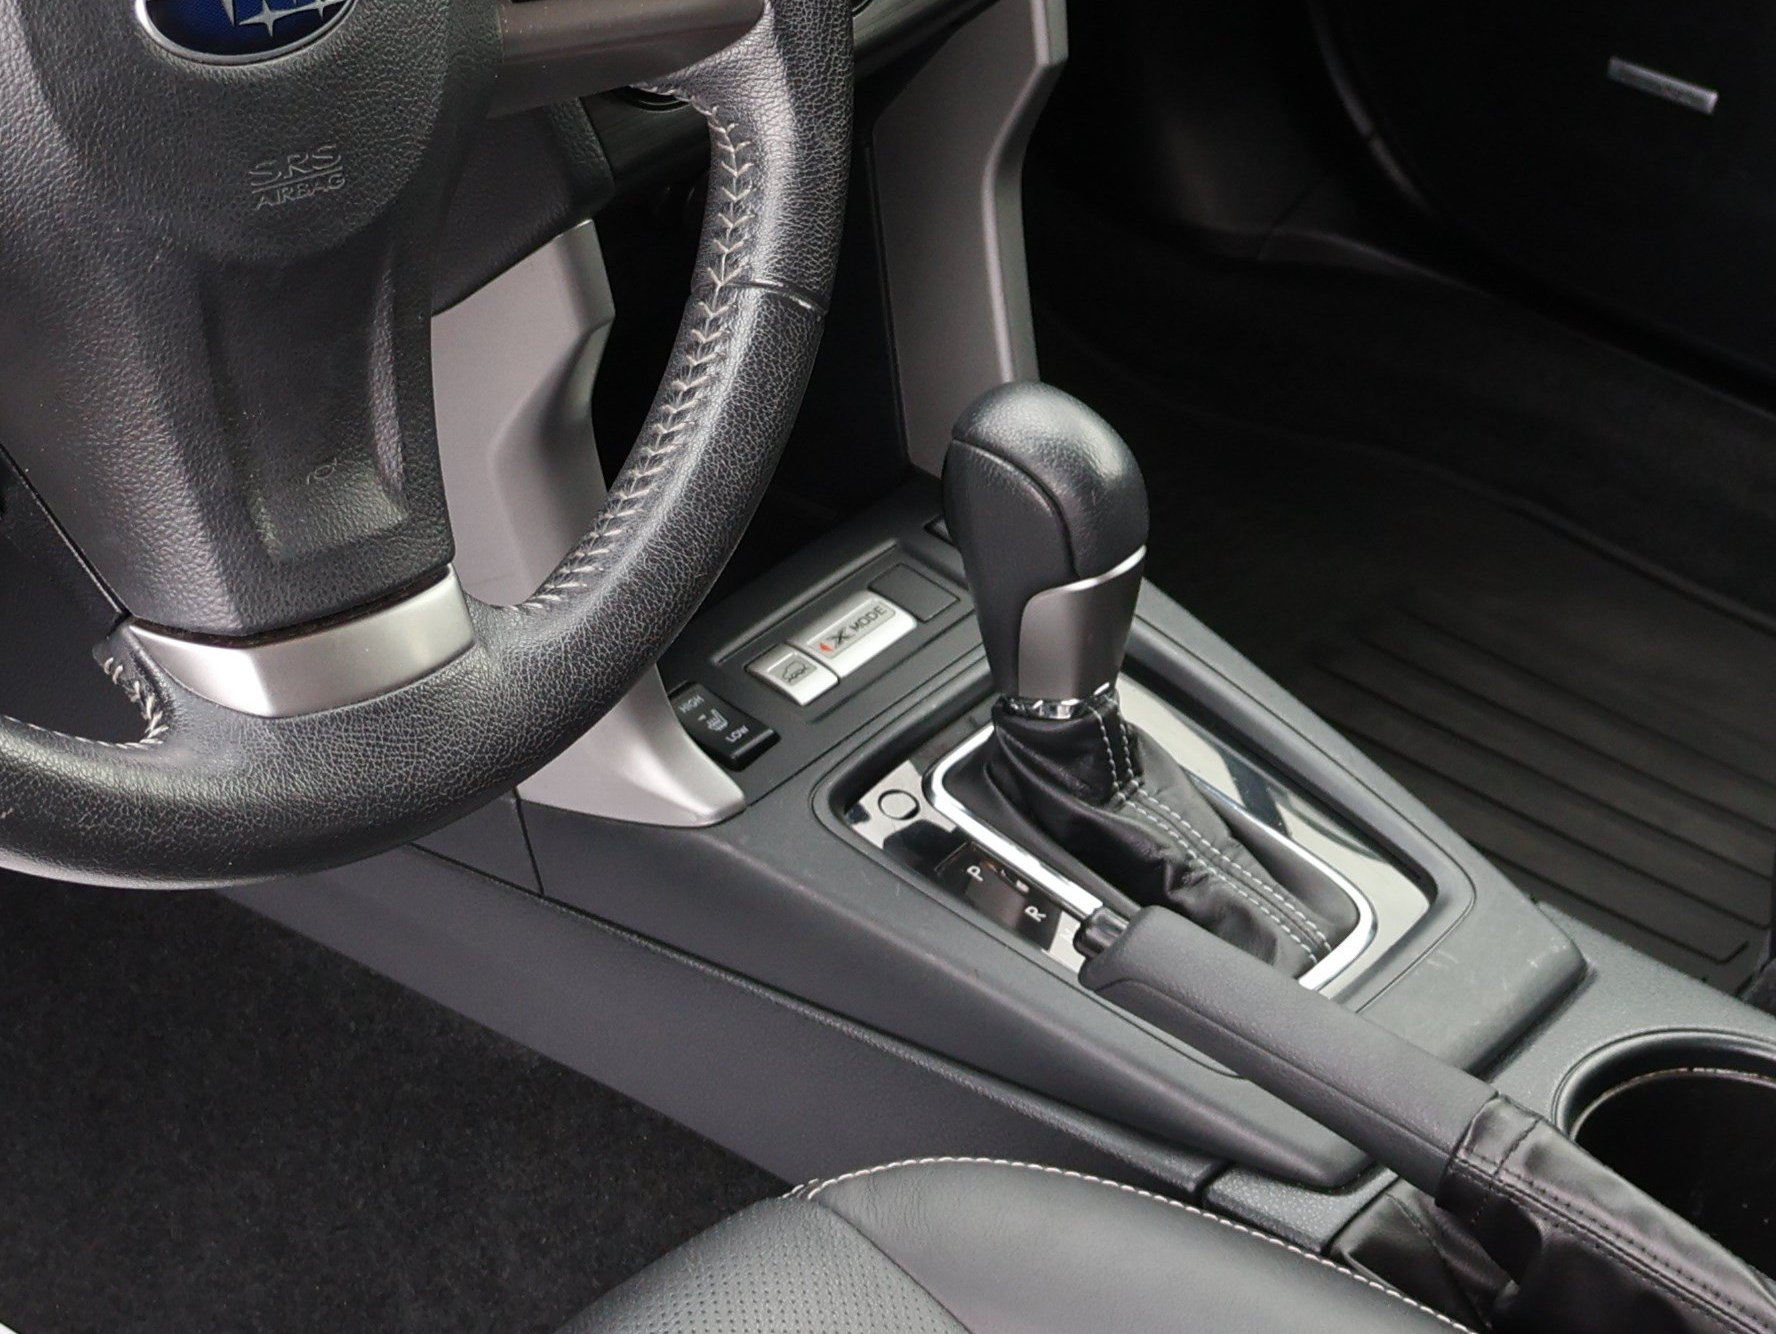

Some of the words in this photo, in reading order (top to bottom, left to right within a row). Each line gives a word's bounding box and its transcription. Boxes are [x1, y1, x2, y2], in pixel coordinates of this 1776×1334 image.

[249, 145, 342, 187] SRS
[256, 173, 346, 211] AIRBAG
[849, 605, 887, 633] MODE
[679, 694, 705, 714] HIGH
[725, 724, 750, 743] LOW
[966, 865, 984, 883] P
[1024, 906, 1048, 923] R
